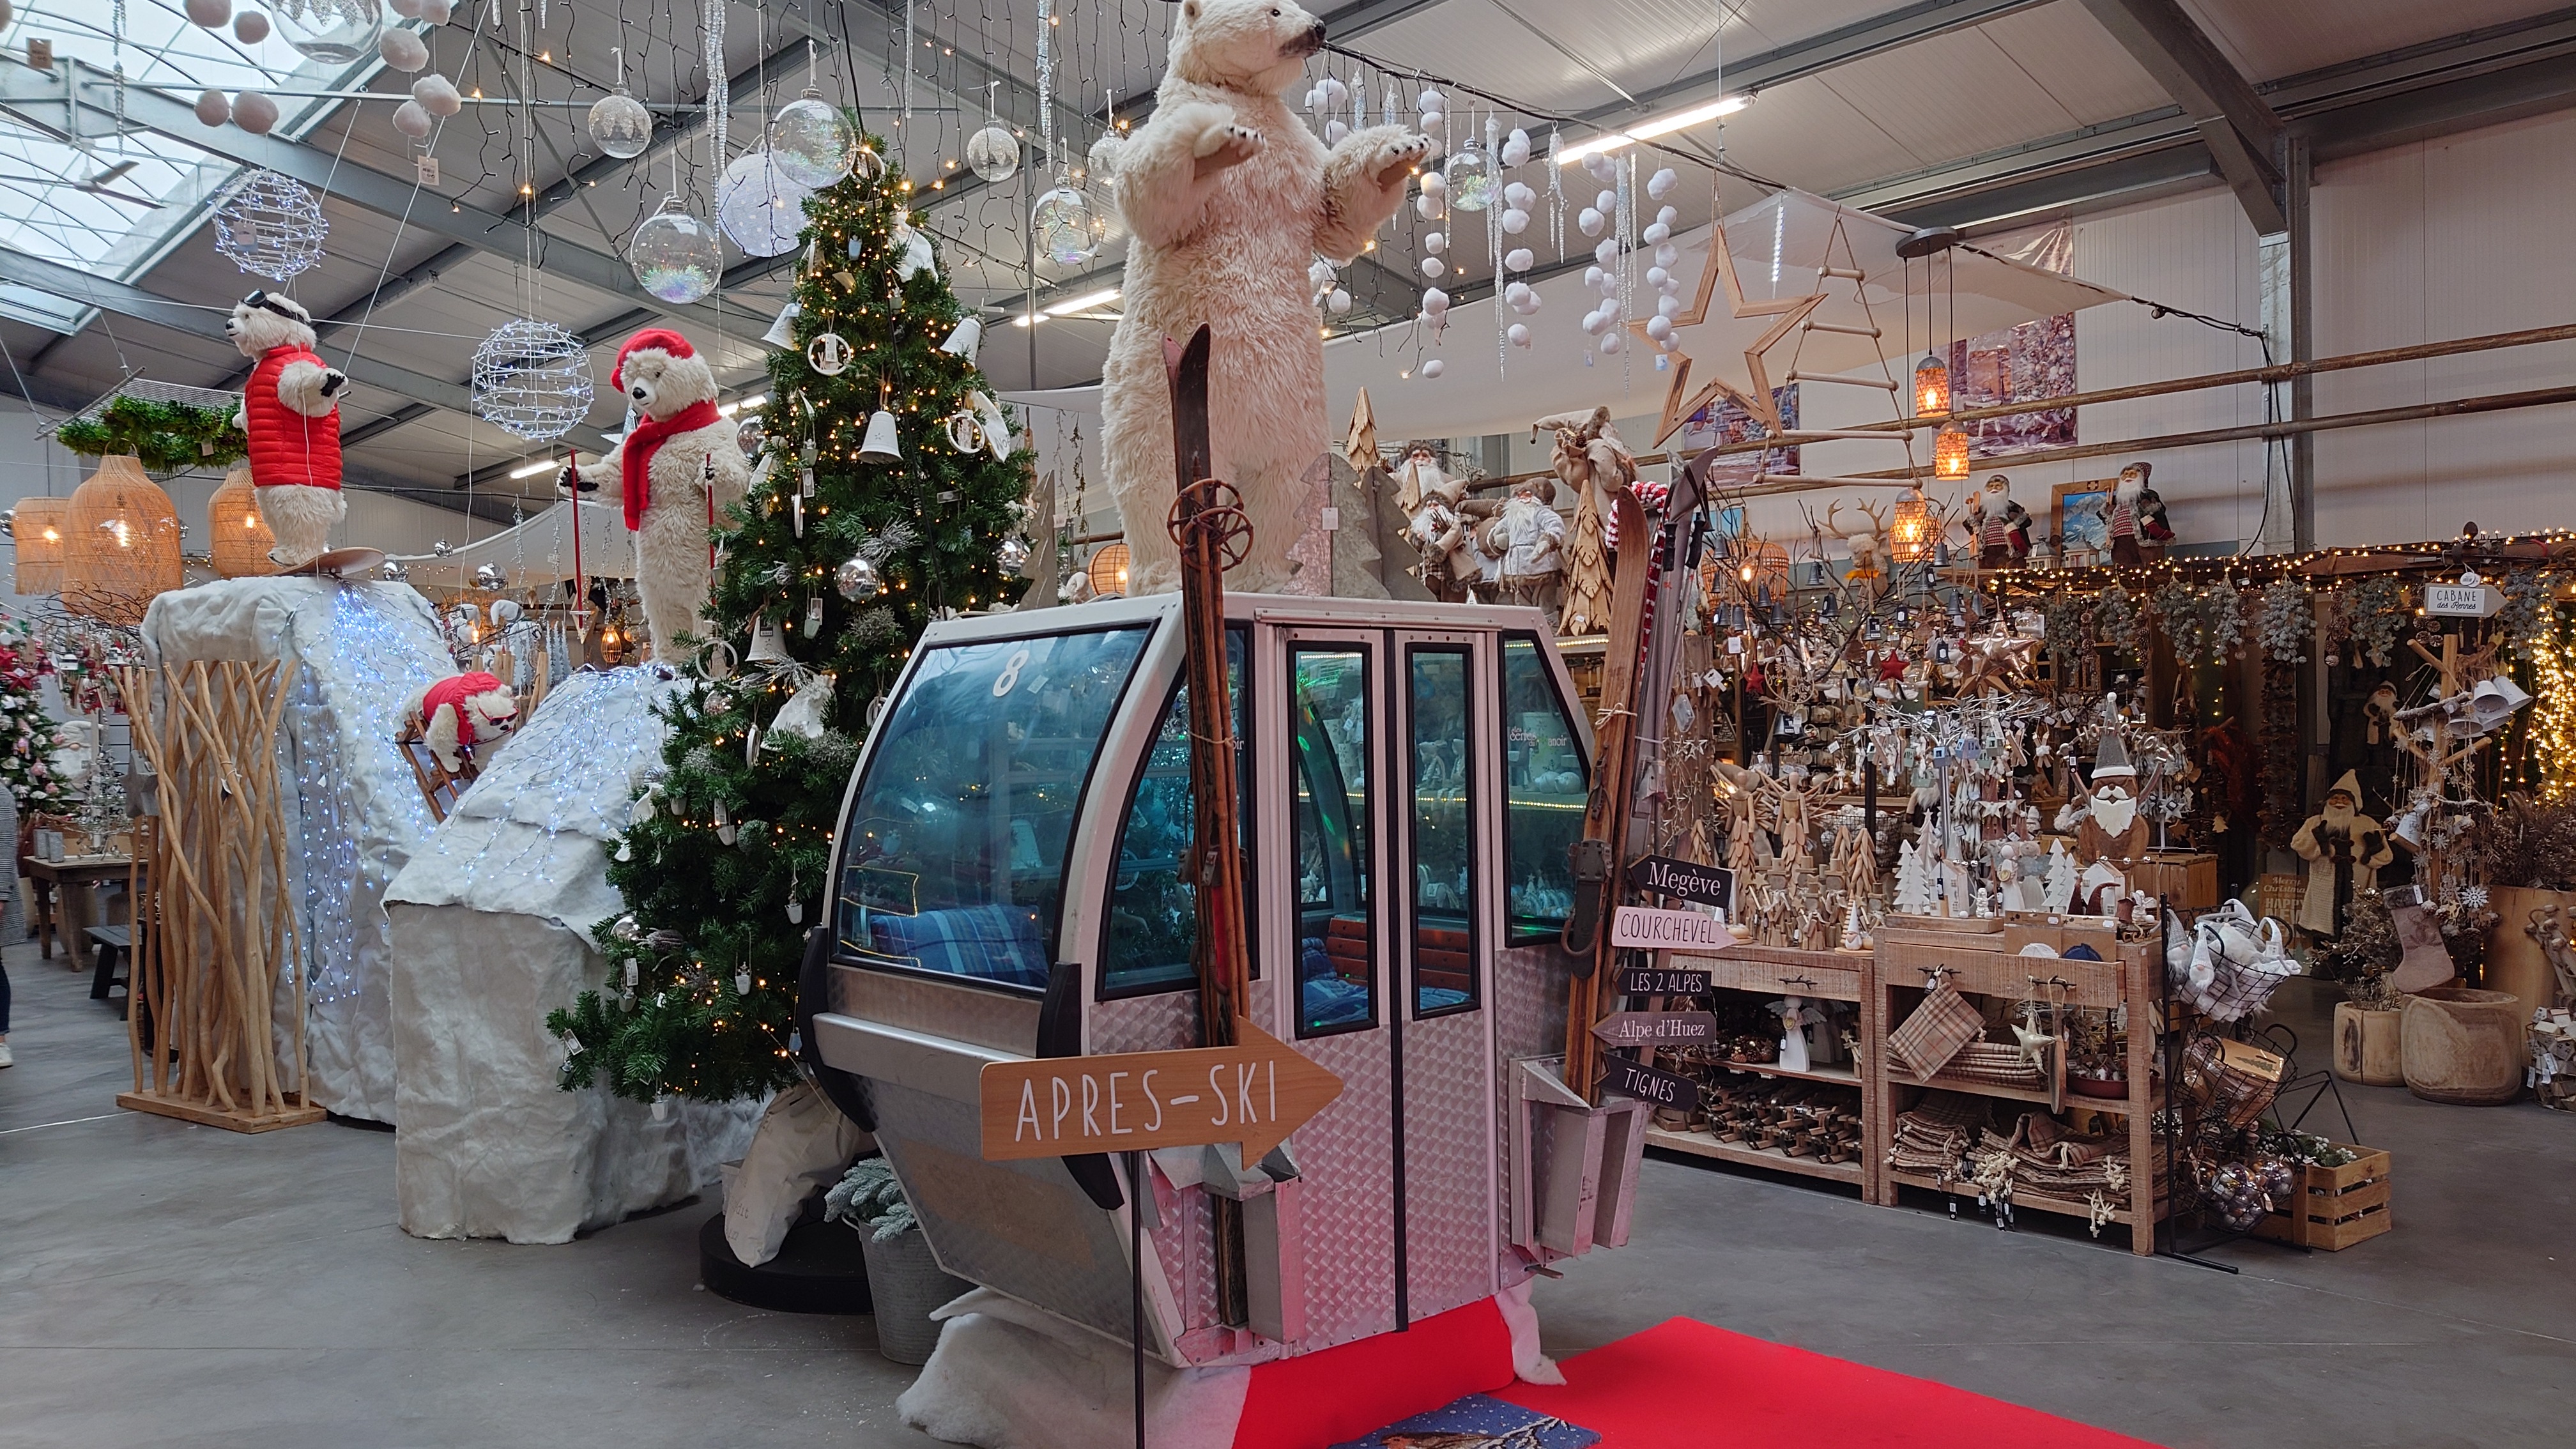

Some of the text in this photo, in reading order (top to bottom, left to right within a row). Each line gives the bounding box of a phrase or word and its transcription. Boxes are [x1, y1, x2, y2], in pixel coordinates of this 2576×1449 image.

[2437, 590, 2476, 602] CABANE
[2451, 601, 2476, 611] Rennes
[992, 649, 1029, 697] 8
[1548, 735, 1567, 746] anoir
[1647, 861, 1721, 896] Megève
[2264, 884, 2306, 893] Christma
[2273, 877, 2301, 887] Merry
[1620, 913, 1716, 944] COURCHEVEL
[1630, 972, 1702, 992] LES 2 ALPES
[1618, 1019, 1705, 1041] Alpe d'Huez
[1625, 1068, 1676, 1103] TIGNES
[1015, 1060, 1275, 1142] APRES-SKI
